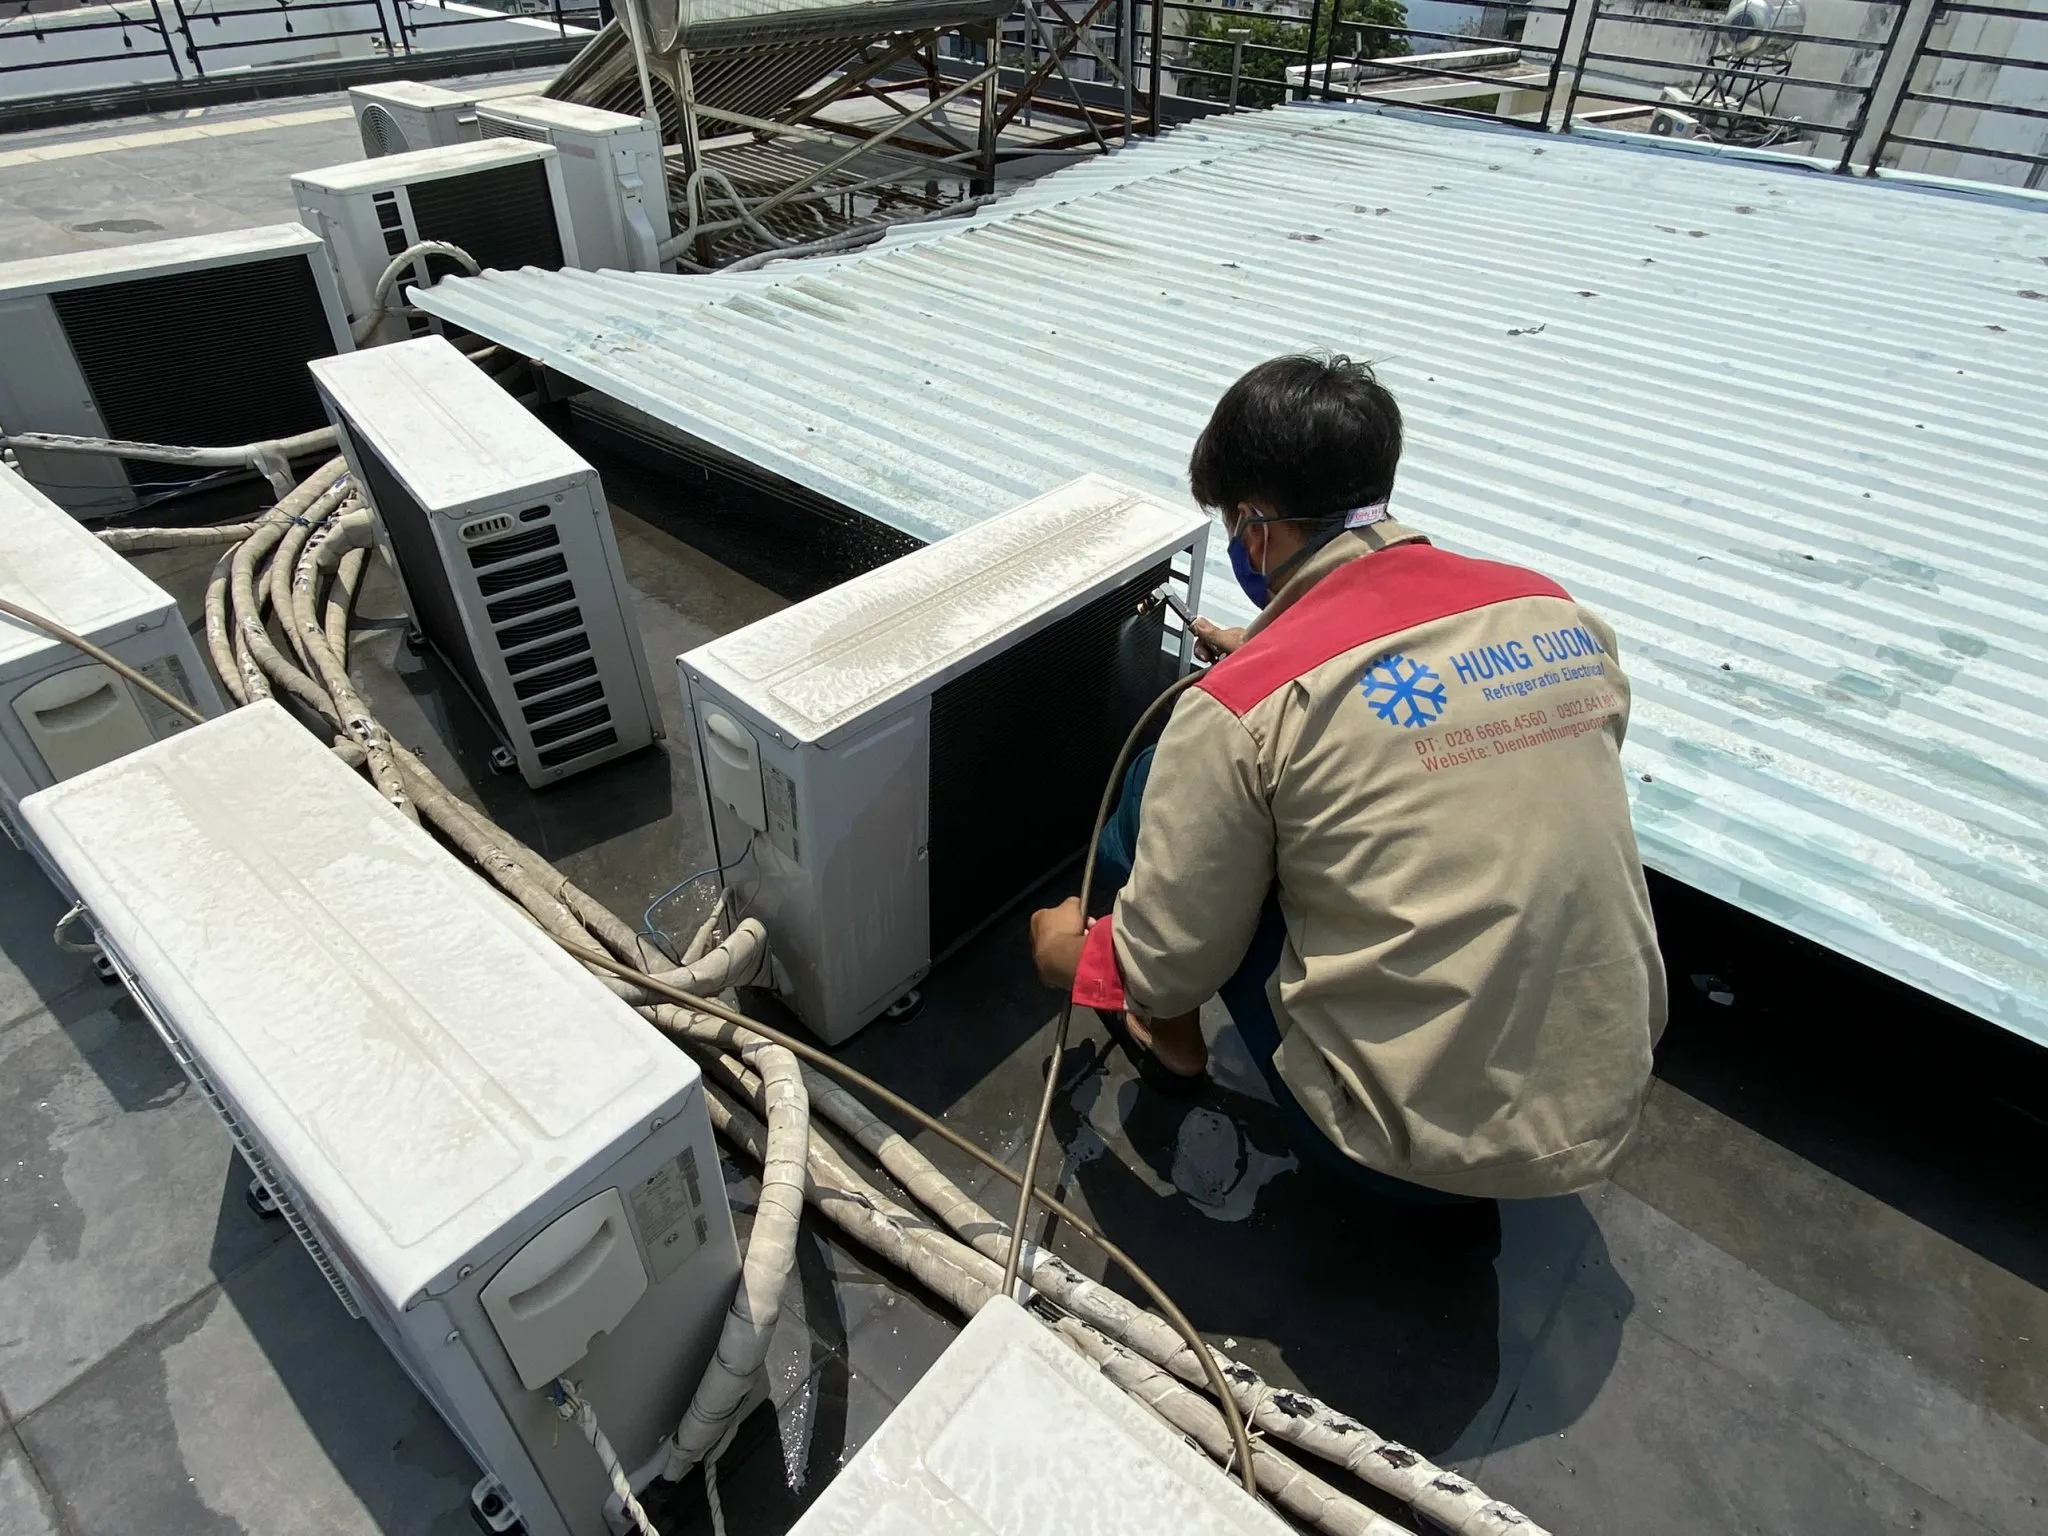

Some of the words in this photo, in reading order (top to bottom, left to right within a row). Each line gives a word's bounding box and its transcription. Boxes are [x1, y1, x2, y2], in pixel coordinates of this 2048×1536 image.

[1449, 640, 1534, 685] HUNG
[1481, 671, 1561, 702] Refrigeratio
[1414, 737, 1442, 756] ĐT:
[1444, 709, 1548, 748] 028.6686.4560
[1421, 746, 1492, 773] Website:
